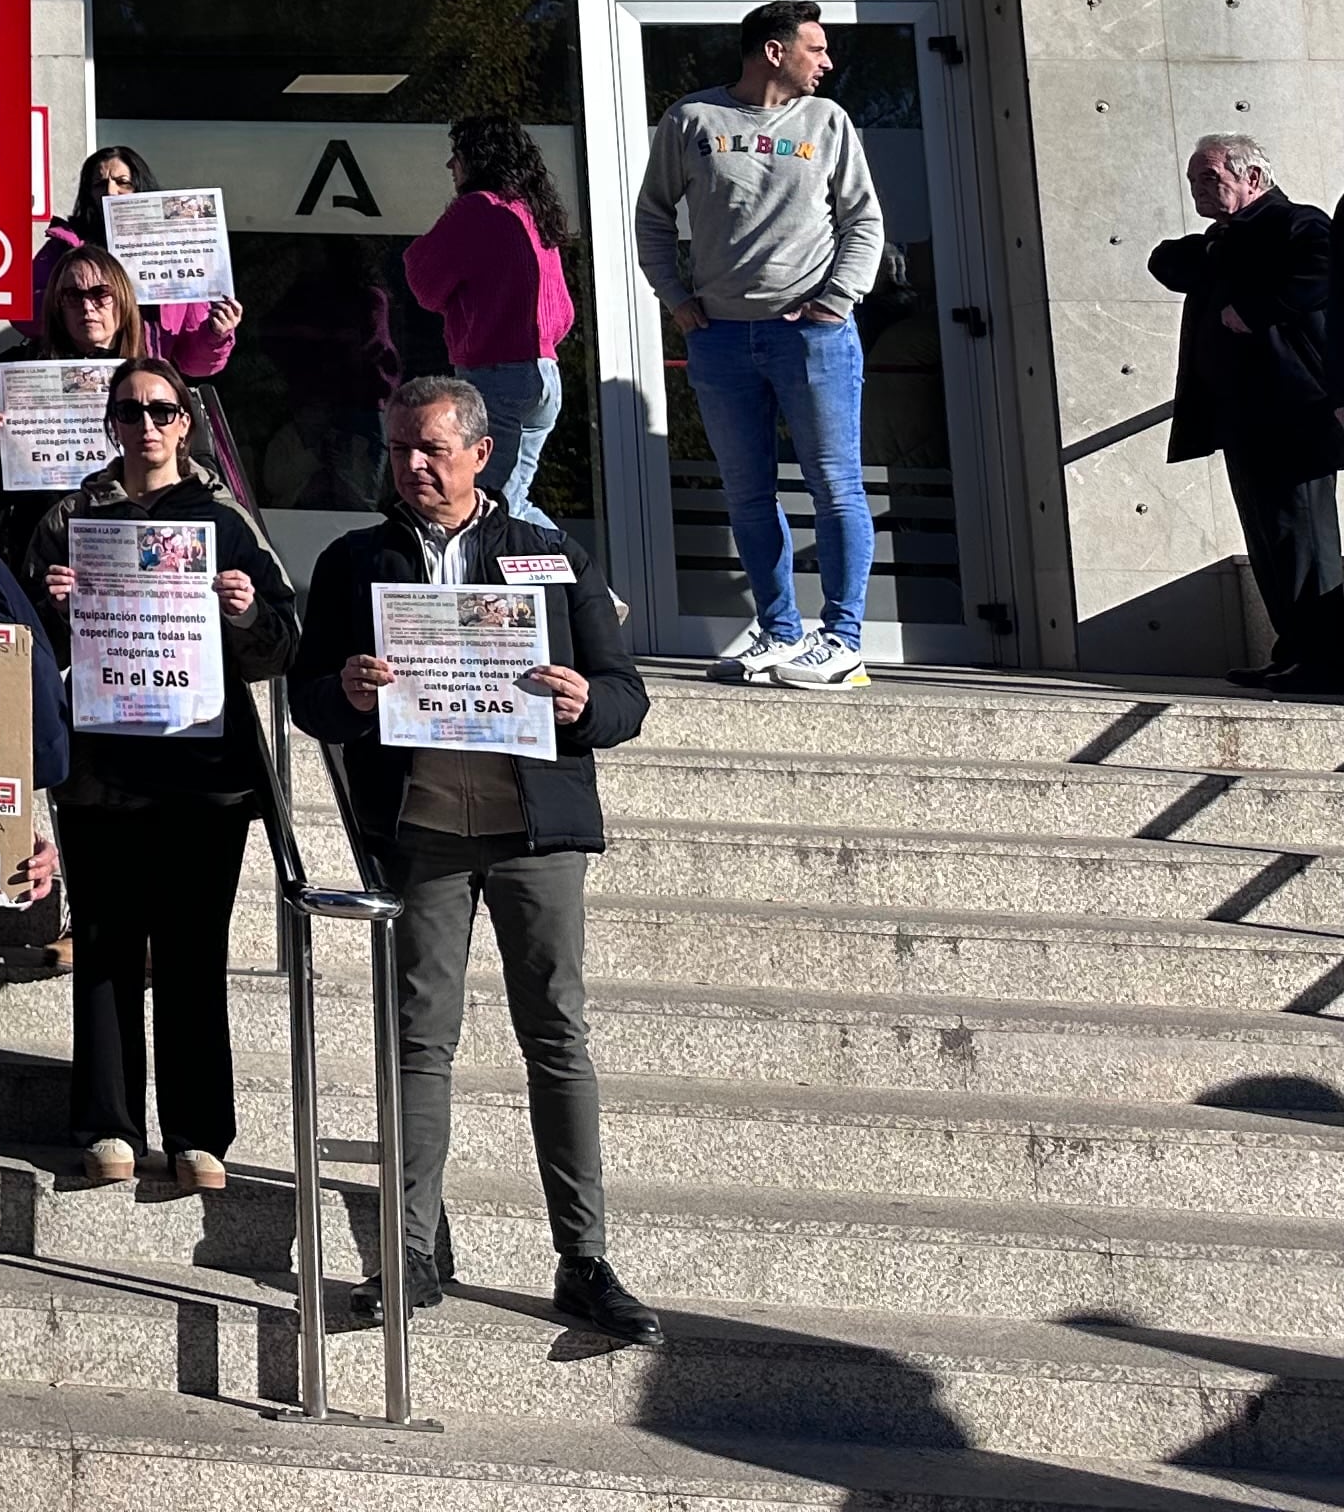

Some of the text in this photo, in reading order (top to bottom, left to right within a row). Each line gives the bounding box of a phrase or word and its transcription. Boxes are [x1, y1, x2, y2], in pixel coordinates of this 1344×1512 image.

[697, 134, 816, 160] SILBON
[140, 268, 204, 280] En el SAS
[32, 451, 106, 461] En el SAS
[74, 609, 206, 624] Equiparación complemento
[80, 628, 202, 641] específico para todas las
[107, 647, 160, 659] categorías
[387, 655, 533, 667] Equiparación complemento
[103, 668, 189, 687] En el SAS
[393, 668, 448, 679] específico
[452, 671, 476, 680] para
[480, 671, 509, 679] todas
[424, 682, 481, 691] categorías
[419, 698, 513, 713] En el SAS
